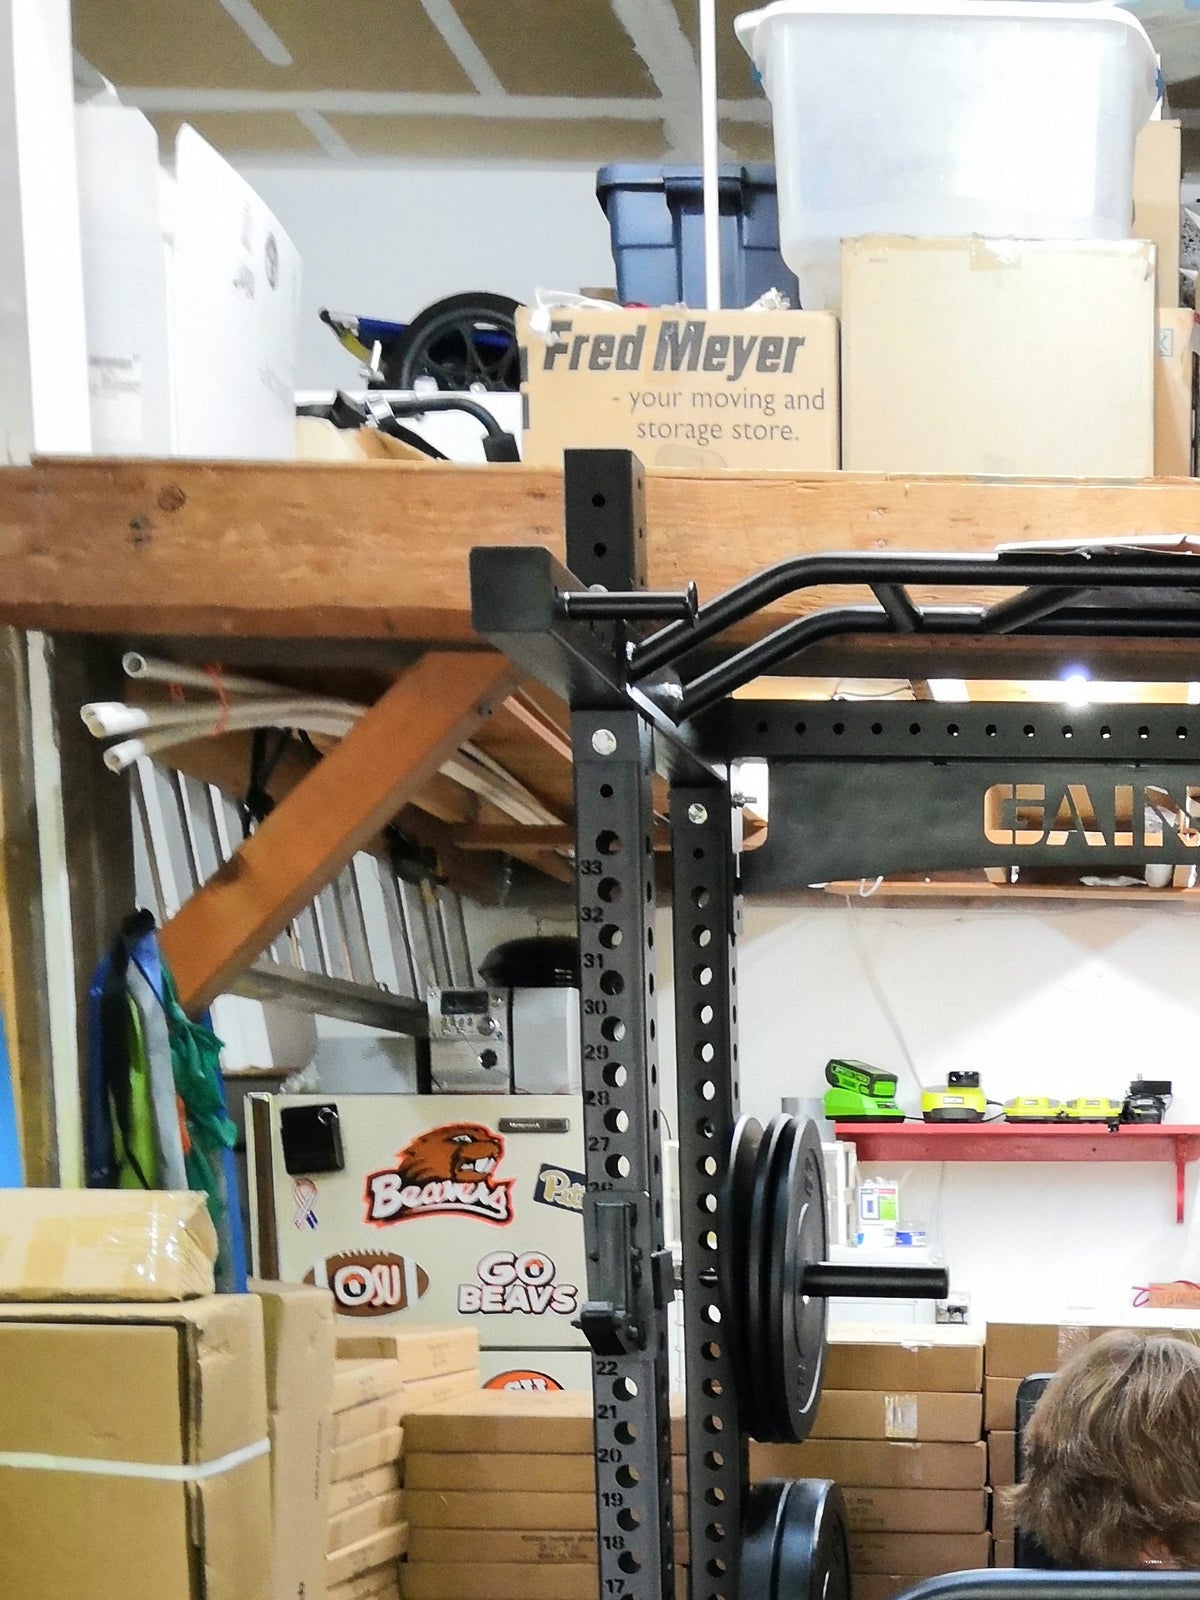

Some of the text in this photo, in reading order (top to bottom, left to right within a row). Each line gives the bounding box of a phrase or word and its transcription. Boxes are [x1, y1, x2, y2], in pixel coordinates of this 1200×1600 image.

[543, 320, 806, 382] Fred Meyer
[628, 387, 825, 415] your moving and
[636, 420, 799, 446] storage store.
[581, 906, 604, 923] 32
[583, 953, 604, 969] 31
[584, 999, 608, 1015] 30
[585, 1044, 609, 1061] 29
[588, 1136, 611, 1151] 27
[477, 1250, 555, 1287] GO
[335, 1264, 401, 1307] OSU
[458, 1283, 579, 1315] BEAVS
[596, 1361, 618, 1376] 22
[597, 1404, 618, 1419] 21
[598, 1448, 622, 1463] 20
[601, 1492, 624, 1507] 19
[602, 1535, 625, 1550] 18
[605, 1578, 625, 1593] 17
